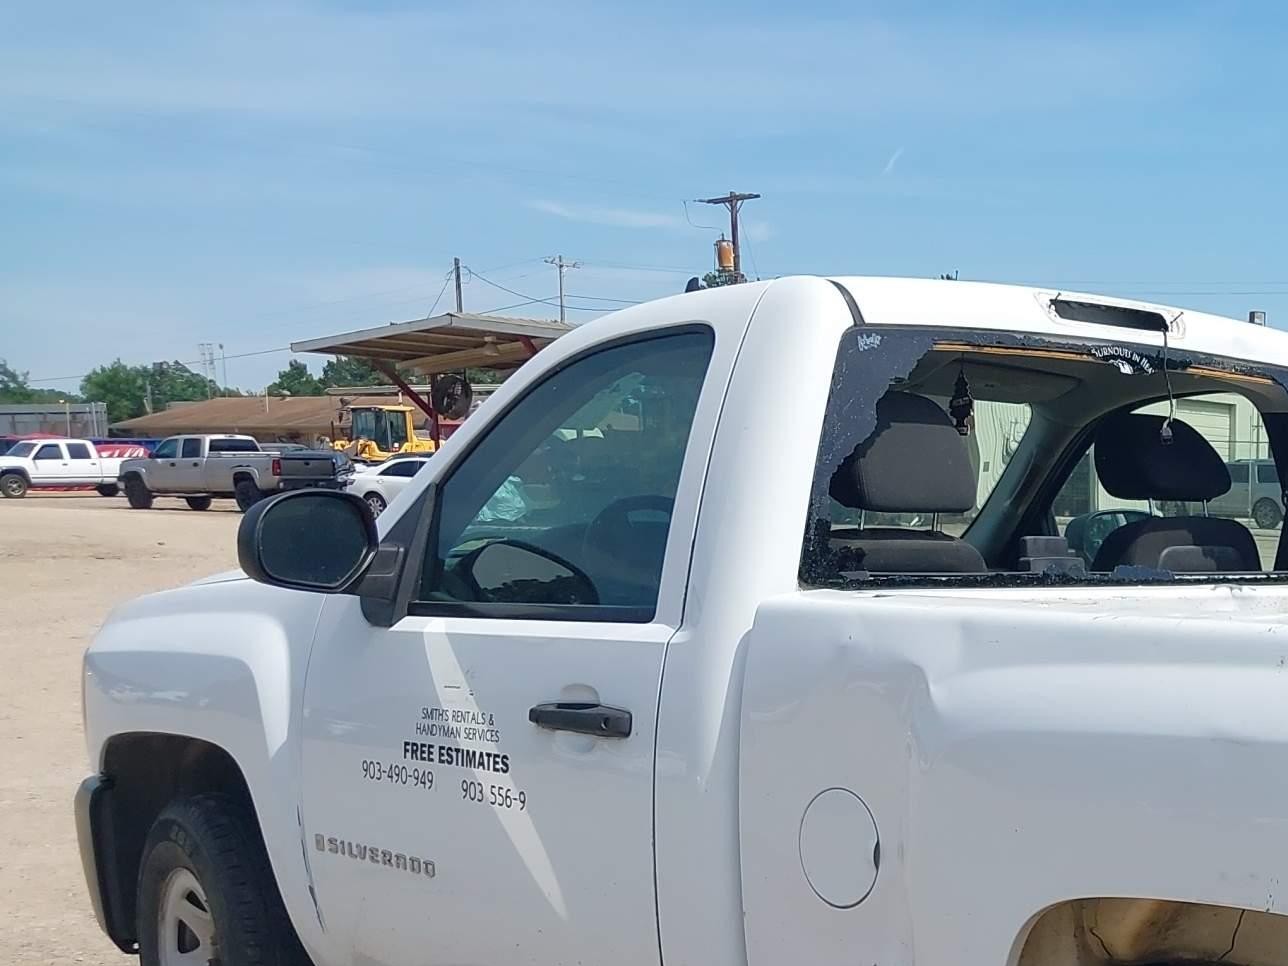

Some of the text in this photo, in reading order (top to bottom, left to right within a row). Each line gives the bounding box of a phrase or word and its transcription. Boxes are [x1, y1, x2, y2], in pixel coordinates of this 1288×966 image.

[415, 723, 500, 743] HANDYMAN SERVICES
[452, 710, 486, 725] RENTALS
[488, 713, 495, 726] &
[403, 741, 510, 774] FREE ESTIMATES
[361, 760, 434, 790] 903-490-949
[461, 779, 527, 811] 903 556-9
[327, 837, 436, 878] SILVERADO
